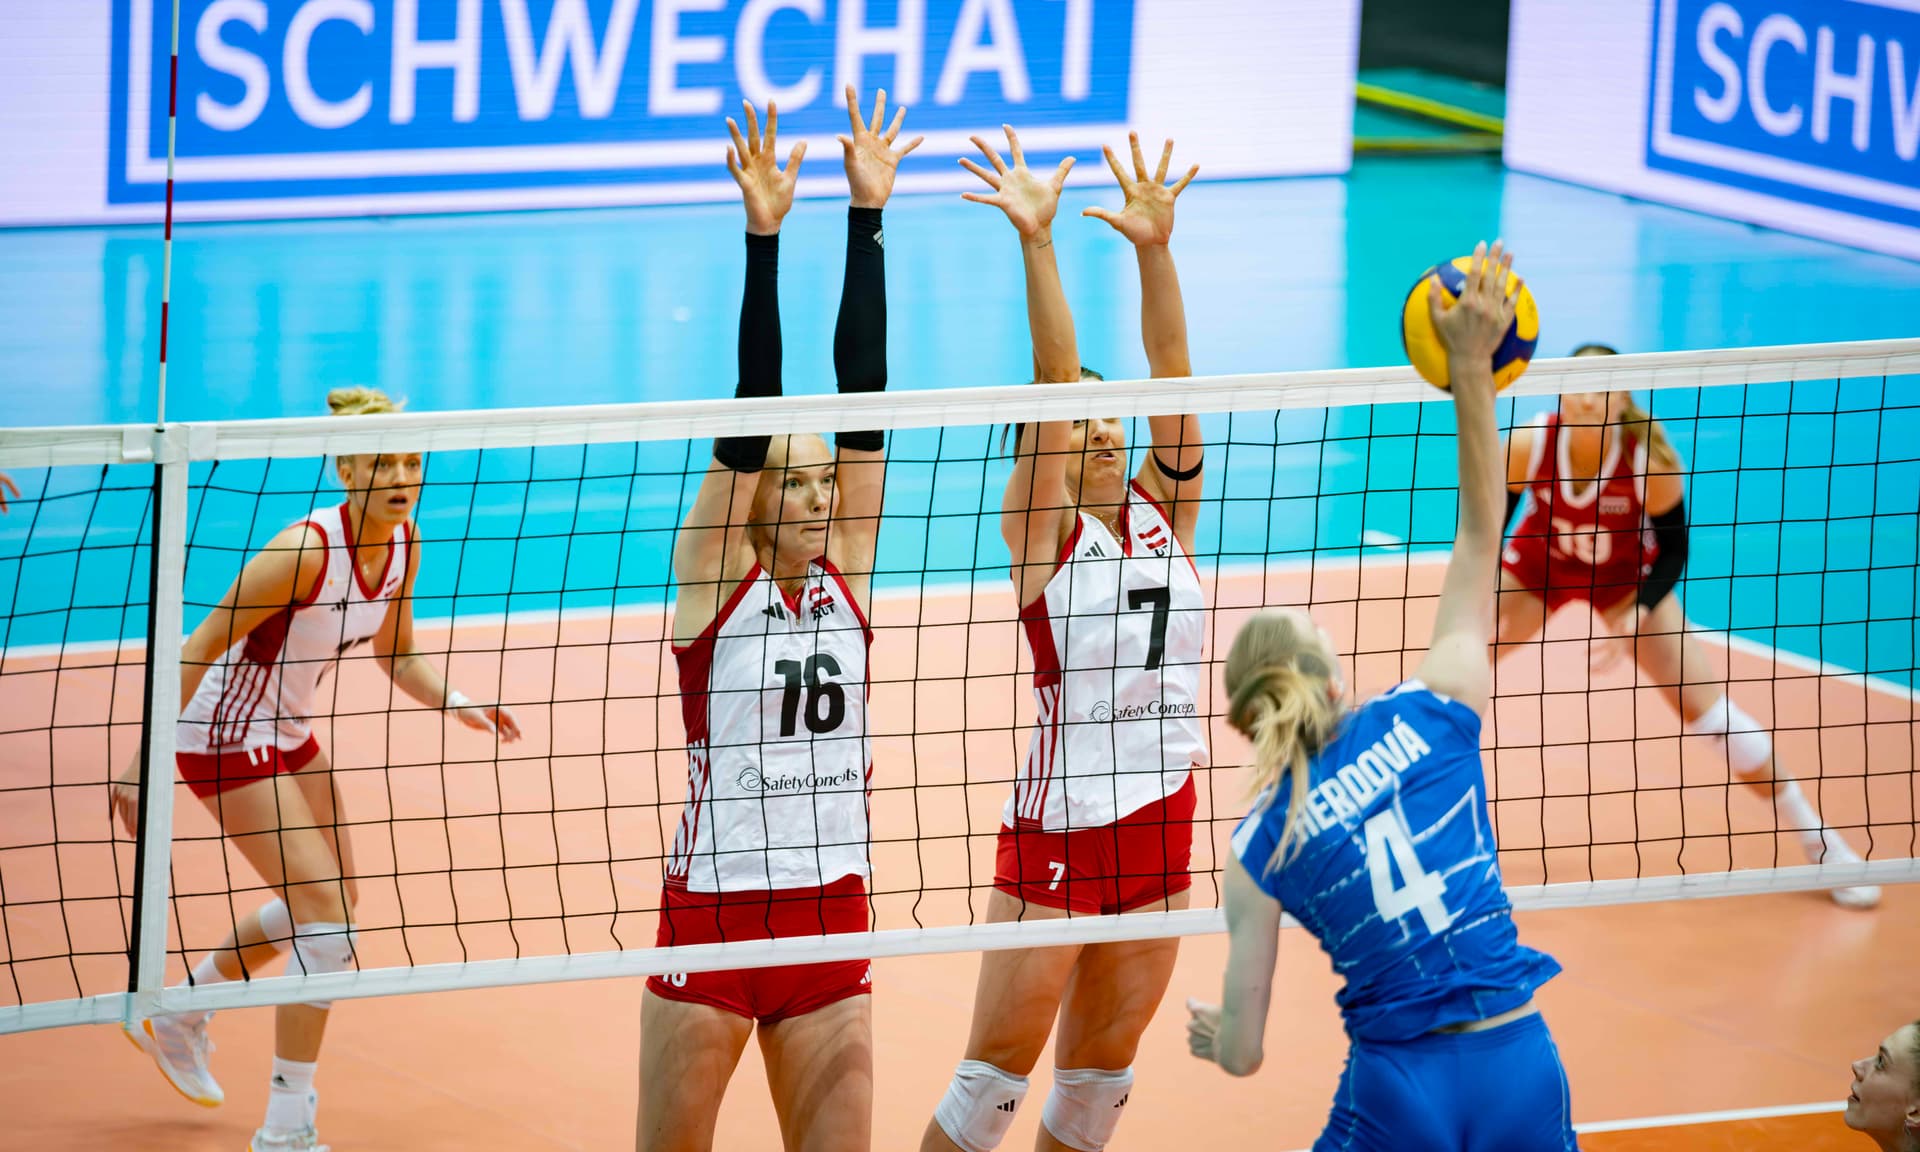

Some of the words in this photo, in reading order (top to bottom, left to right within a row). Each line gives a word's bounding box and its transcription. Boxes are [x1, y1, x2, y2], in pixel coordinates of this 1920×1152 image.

[813, 602, 835, 621] AUT
[1128, 586, 1171, 671] 7
[774, 653, 846, 738] 16
[1048, 861, 1066, 890] 7
[1364, 808, 1451, 936] 4
